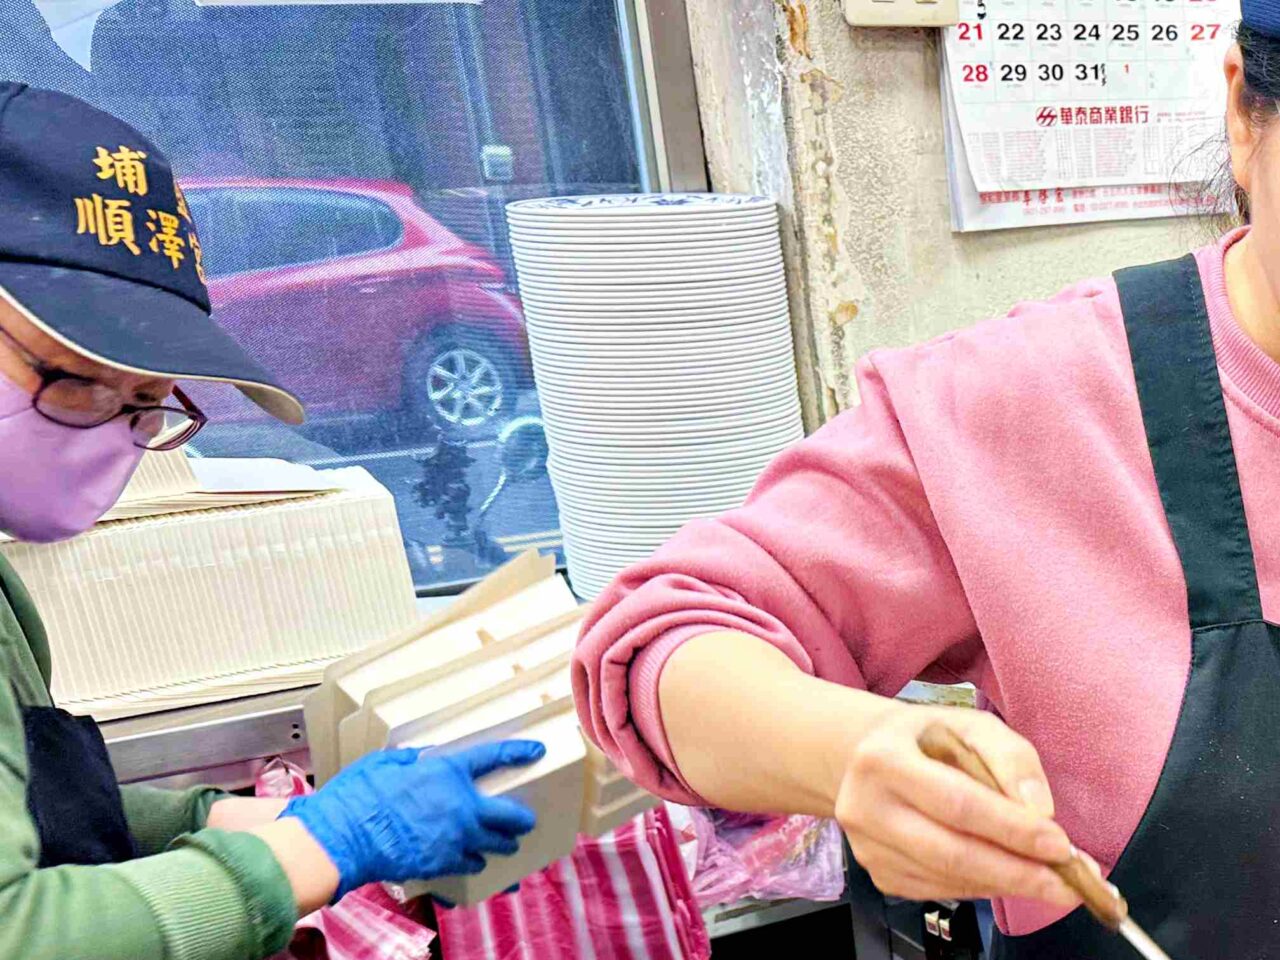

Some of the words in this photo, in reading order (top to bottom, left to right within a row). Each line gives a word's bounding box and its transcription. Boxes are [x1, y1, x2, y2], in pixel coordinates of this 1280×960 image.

[957, 22, 983, 41] 21
[997, 22, 1024, 41] 22
[1036, 23, 1063, 41] 23
[1073, 23, 1100, 41] 24
[1111, 24, 1140, 41] 25
[1151, 24, 1178, 41] 26
[1190, 24, 1221, 41] 27
[962, 64, 989, 82] 28
[1000, 64, 1027, 82] 29
[1038, 64, 1064, 81] 30
[1075, 63, 1099, 81] 31
[1124, 63, 1130, 74] 1
[1060, 105, 1149, 125] 華泰商業銀行
